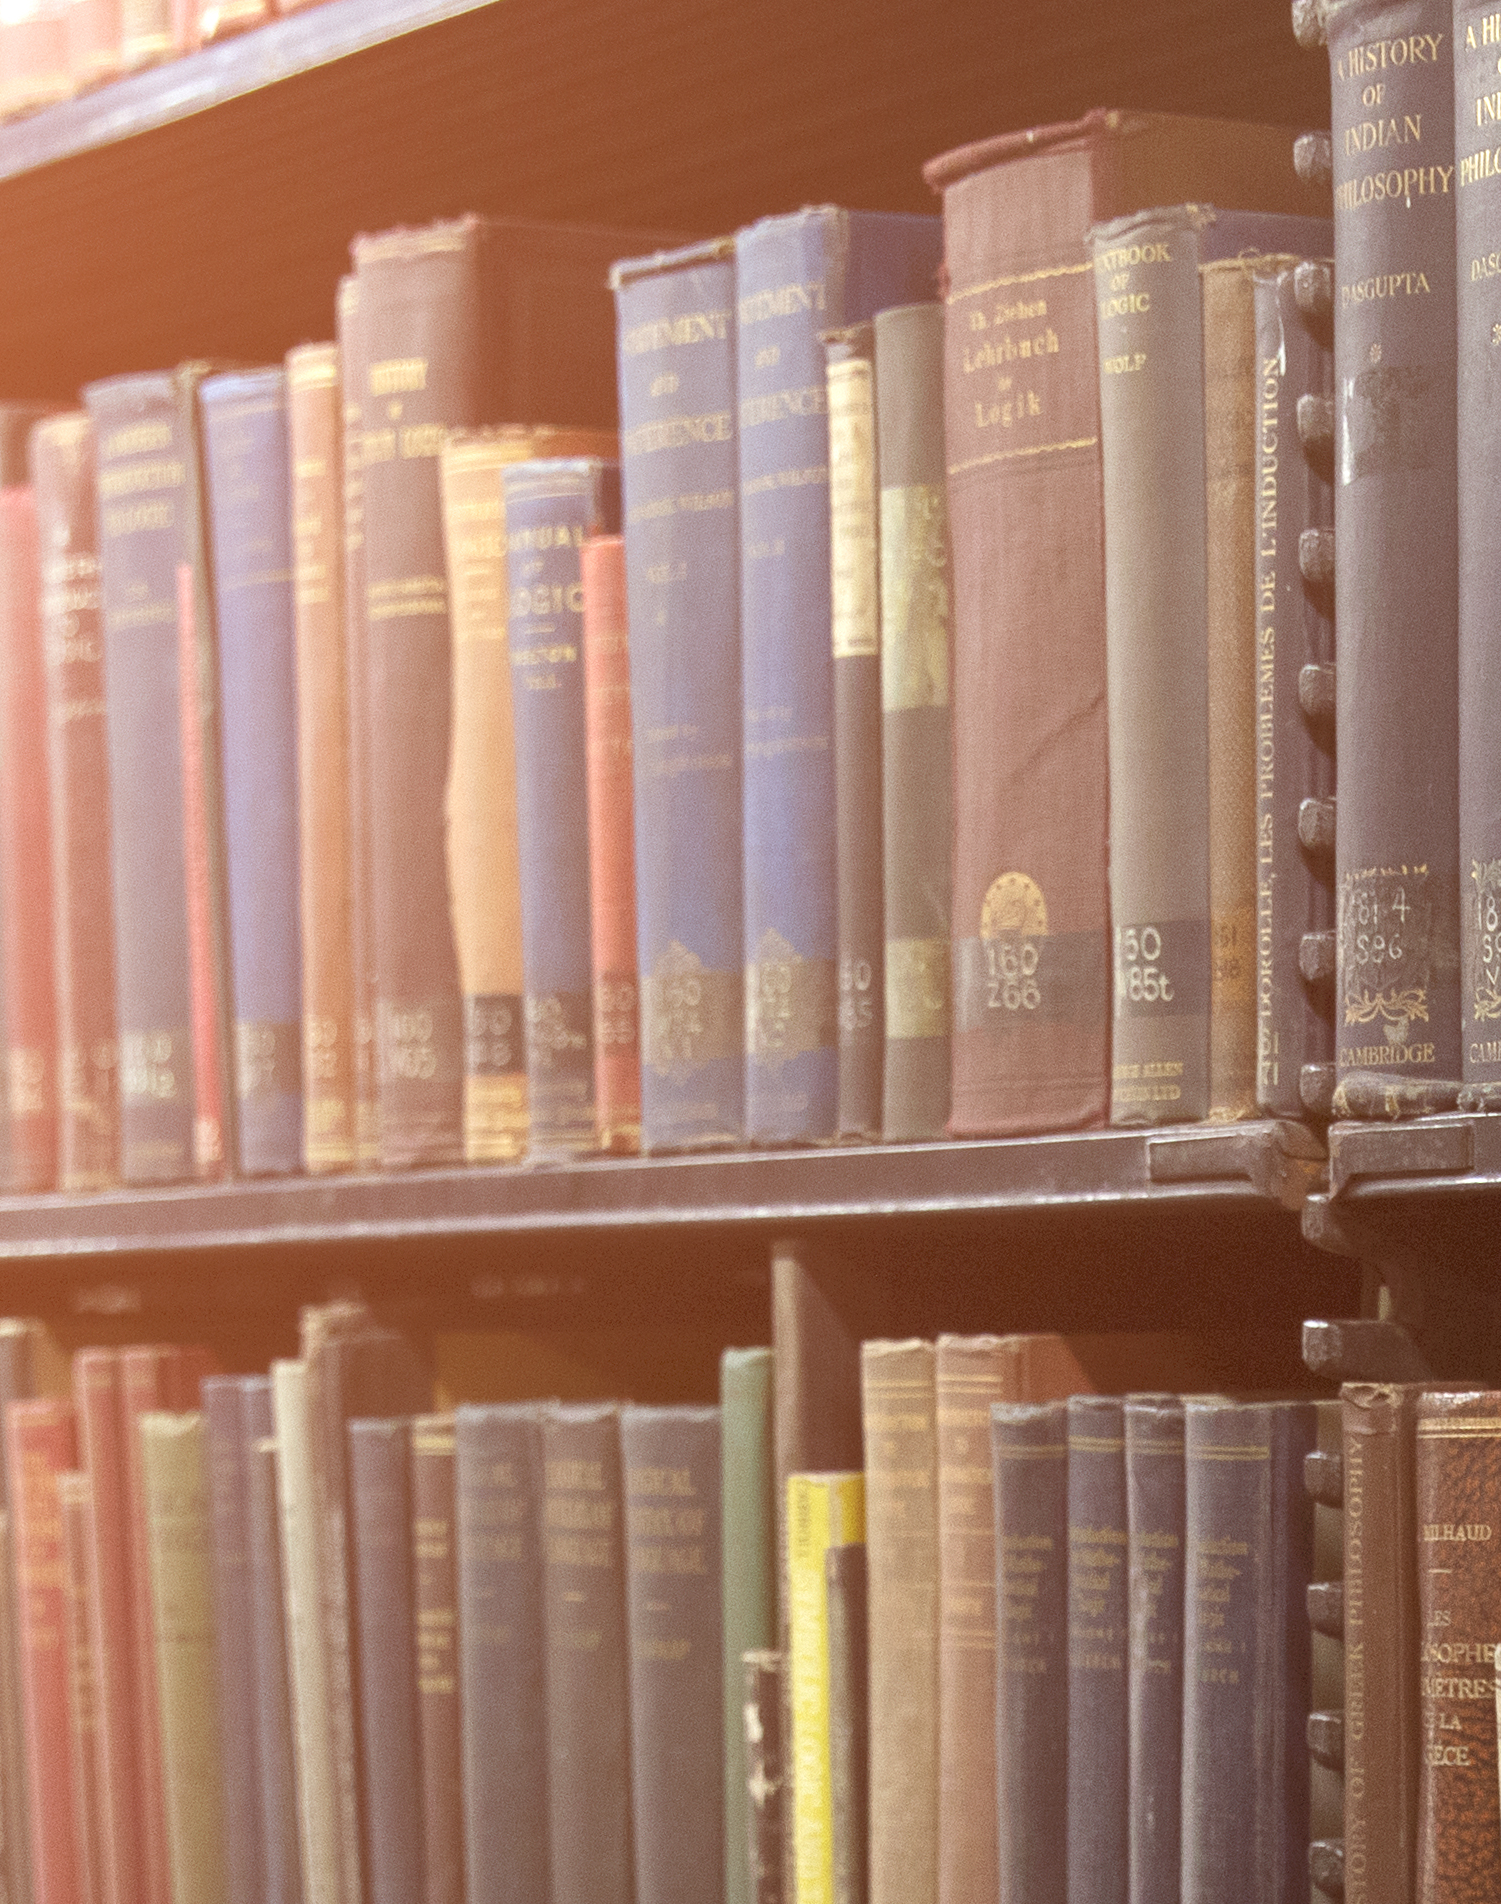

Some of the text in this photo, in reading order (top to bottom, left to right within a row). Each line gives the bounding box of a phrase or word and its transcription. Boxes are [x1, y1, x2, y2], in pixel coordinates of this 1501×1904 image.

[1348, 34, 1443, 75] HISTORY
[1465, 26, 1476, 51] A
[1363, 85, 1385, 106] OF
[1345, 115, 1422, 156] INDIAN
[1342, 272, 1430, 308] DASGUPTA
[1260, 357, 1281, 557] L'INDUCTION
[1261, 571, 1277, 613] DE
[1259, 626, 1276, 799] PROBLEMES
[1259, 813, 1274, 866] LES
